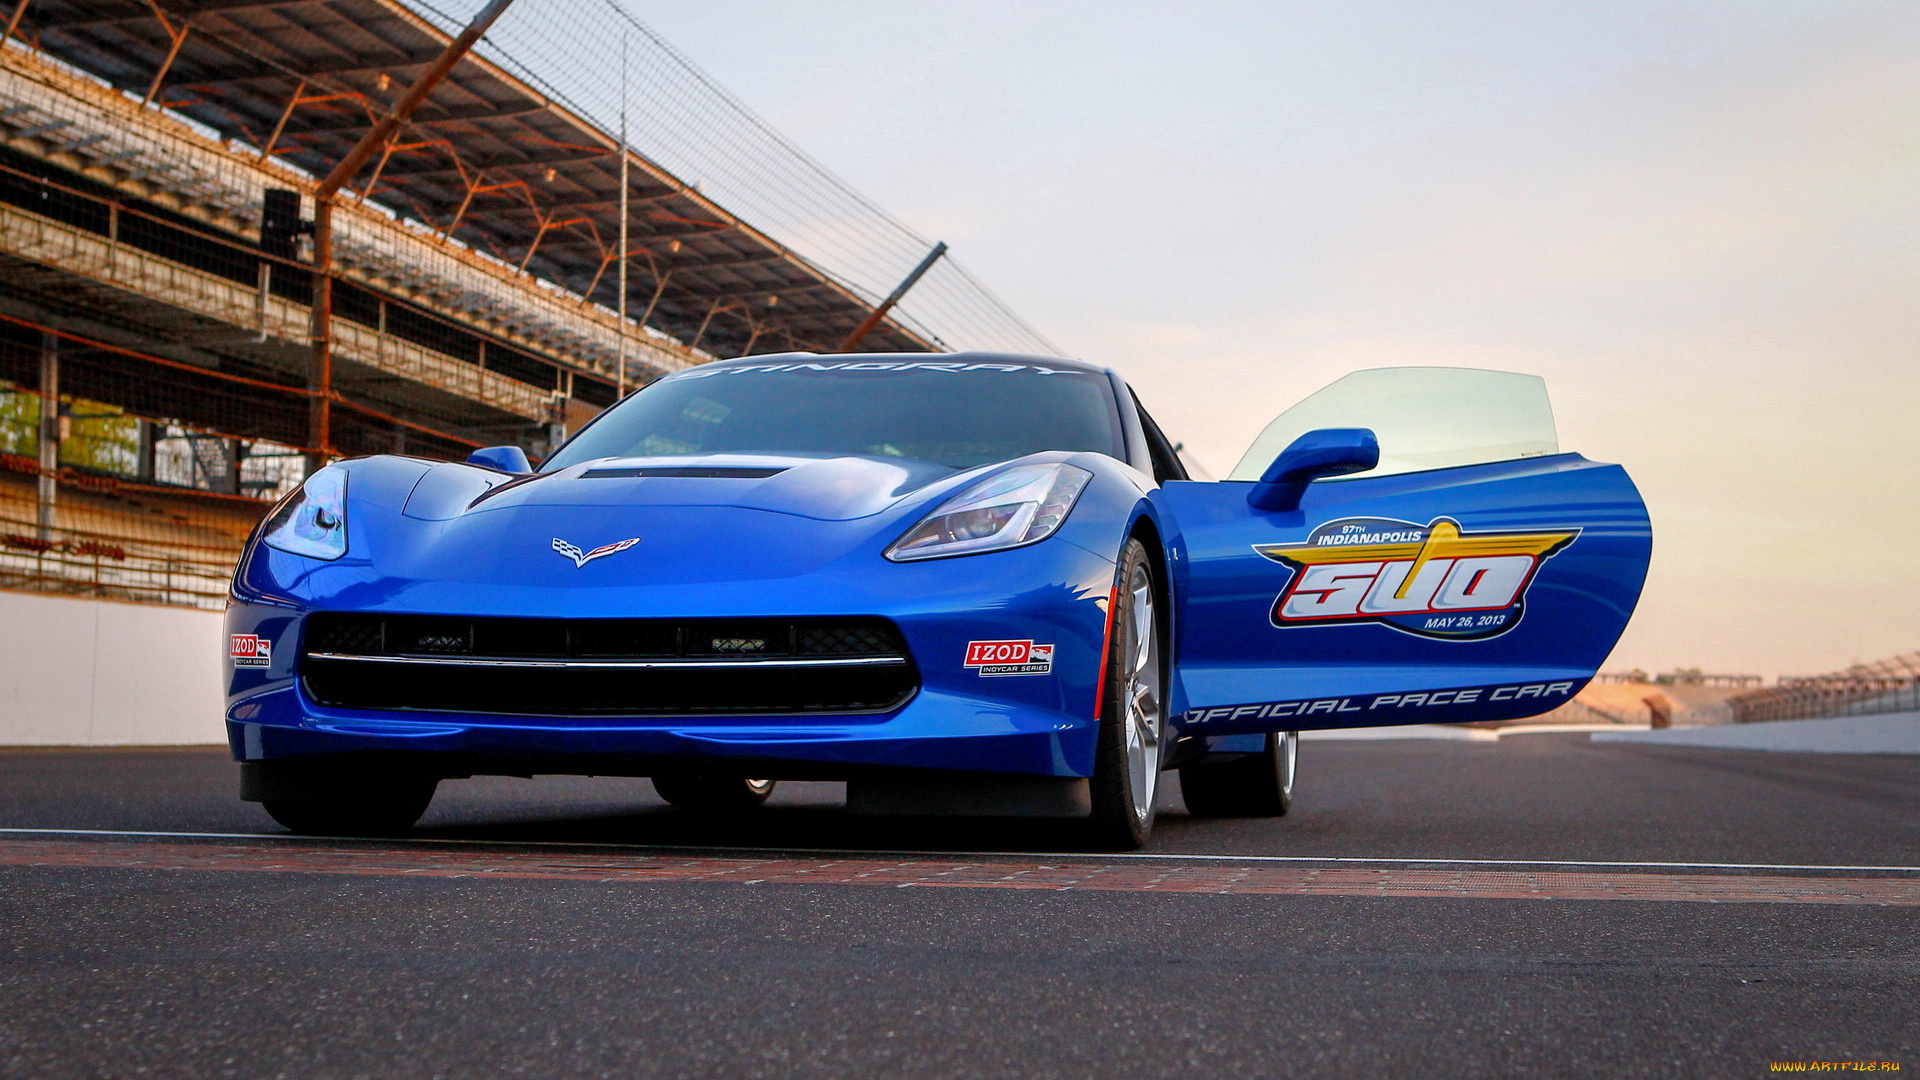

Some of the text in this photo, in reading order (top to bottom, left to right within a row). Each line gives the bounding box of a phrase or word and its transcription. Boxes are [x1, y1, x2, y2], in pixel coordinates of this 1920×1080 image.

[666, 363, 1085, 381] STINGRAY
[1342, 525, 1365, 534] 97TH
[1317, 531, 1422, 546] INDIANAPOLIS
[1424, 615, 1506, 628] MAY 26, 2013
[232, 638, 255, 653] IZOD
[971, 644, 1026, 661] IZOD
[1020, 664, 1049, 672] SERIES
[1183, 681, 1574, 724] OFFICIAL PACE CAR
